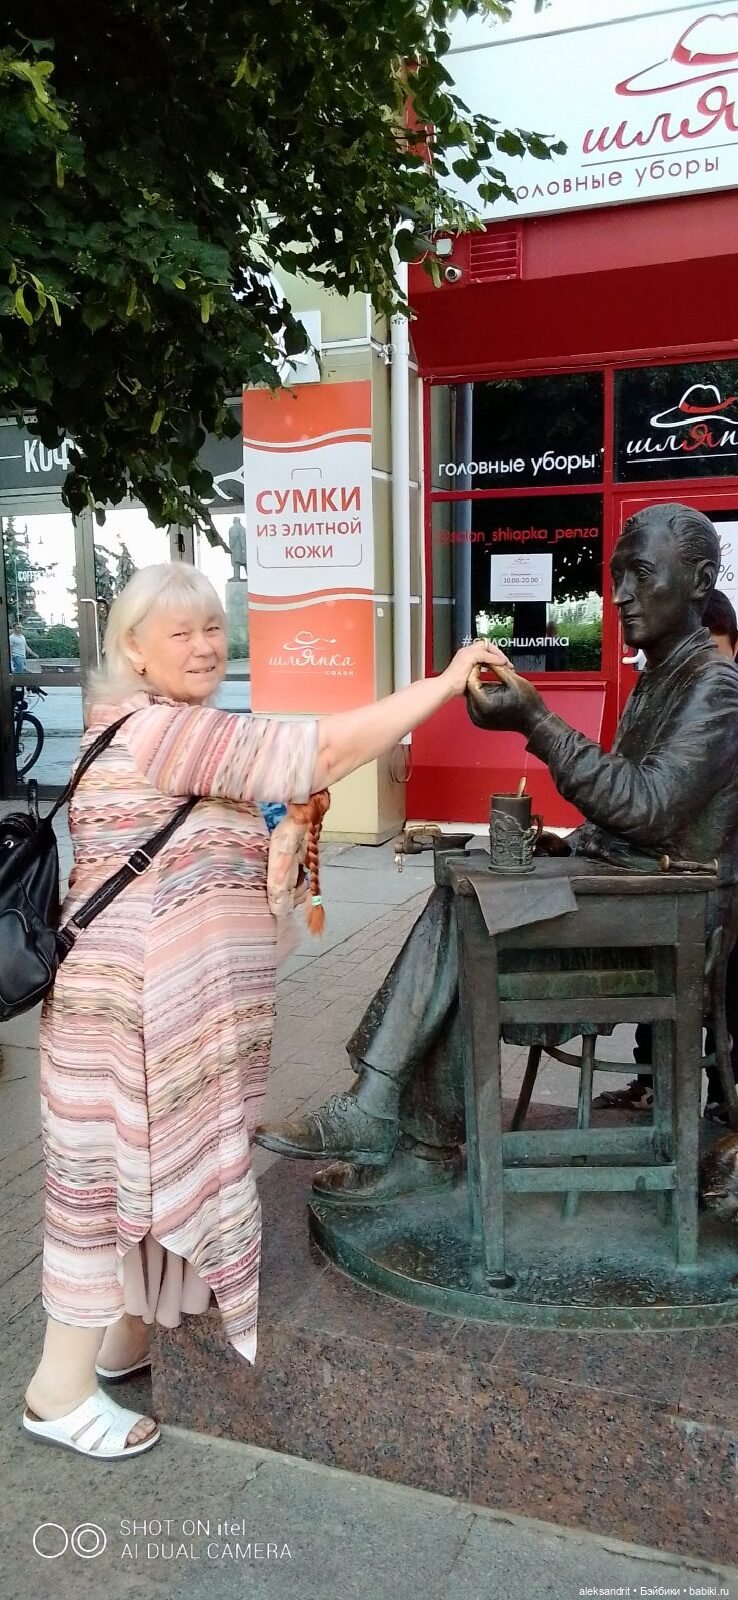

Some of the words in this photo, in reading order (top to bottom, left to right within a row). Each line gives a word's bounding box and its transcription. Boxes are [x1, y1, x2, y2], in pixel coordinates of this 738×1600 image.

[510, 171, 622, 200] оловные
[635, 156, 719, 187] уборы
[24, 438, 83, 473] КОФ
[438, 458, 525, 477] головные
[531, 451, 595, 476] уборы
[255, 486, 362, 516] СУМКИ
[256, 523, 277, 537] ИЗ
[282, 517, 362, 537] ЭЛИТНОЙ
[285, 545, 334, 559] КОЖИ
[462, 634, 570, 648] #лоншляпка
